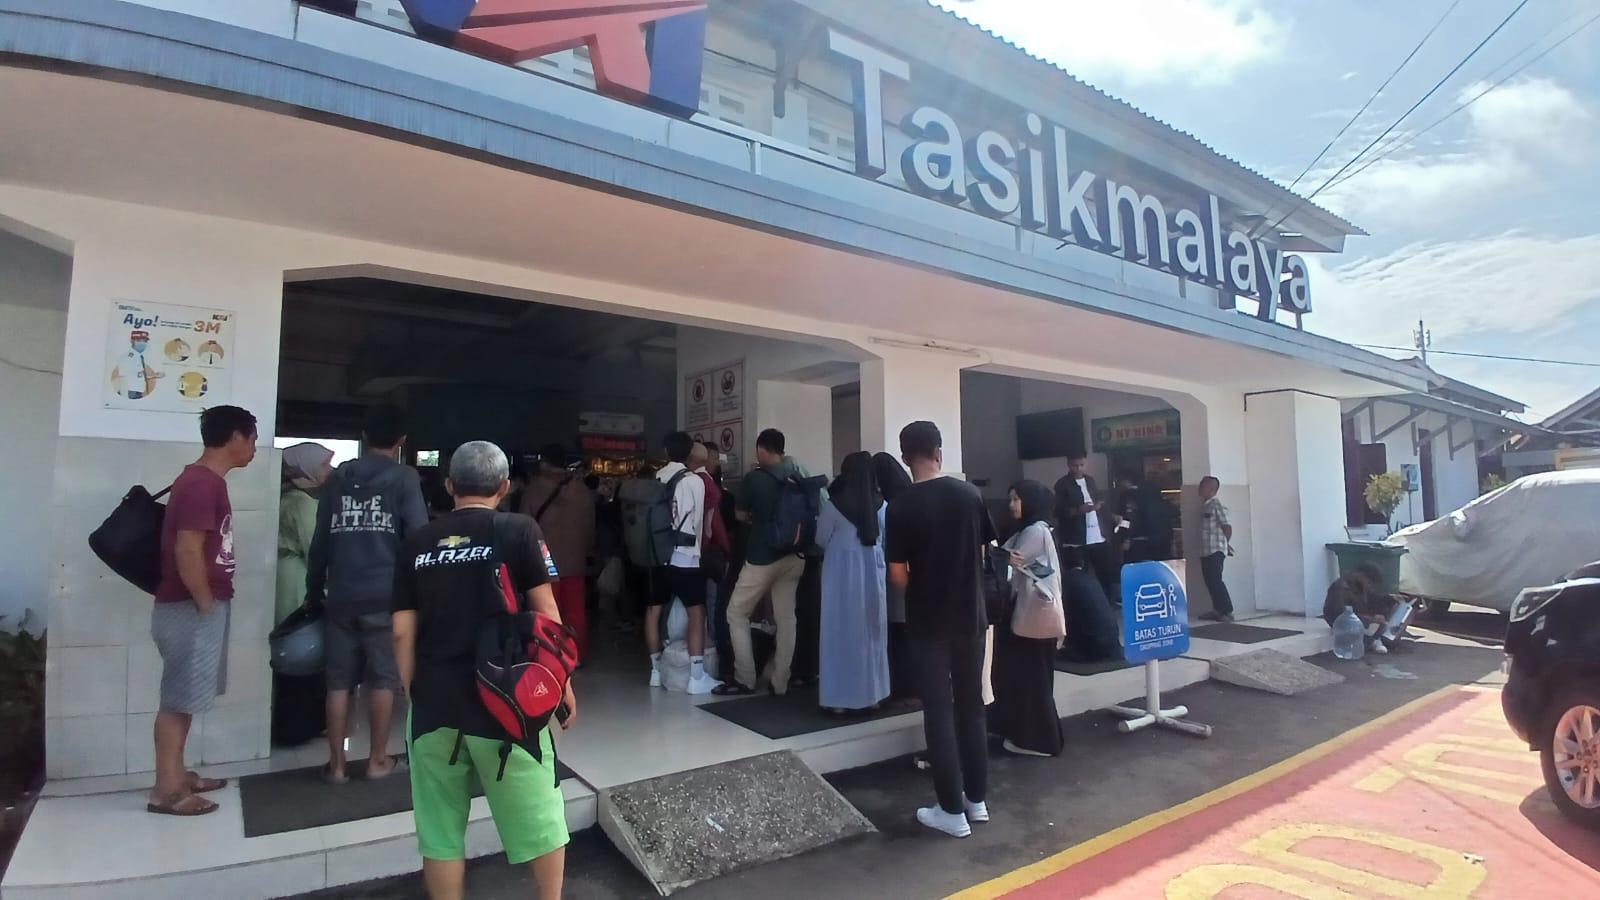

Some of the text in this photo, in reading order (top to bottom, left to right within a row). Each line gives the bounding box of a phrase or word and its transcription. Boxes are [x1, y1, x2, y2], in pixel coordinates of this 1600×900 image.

[829, 28, 1312, 321] Tasikmalaya
[123, 313, 159, 329] Ayo!
[194, 320, 221, 334] 3M
[1134, 623, 1181, 641] BATAS TURUN
